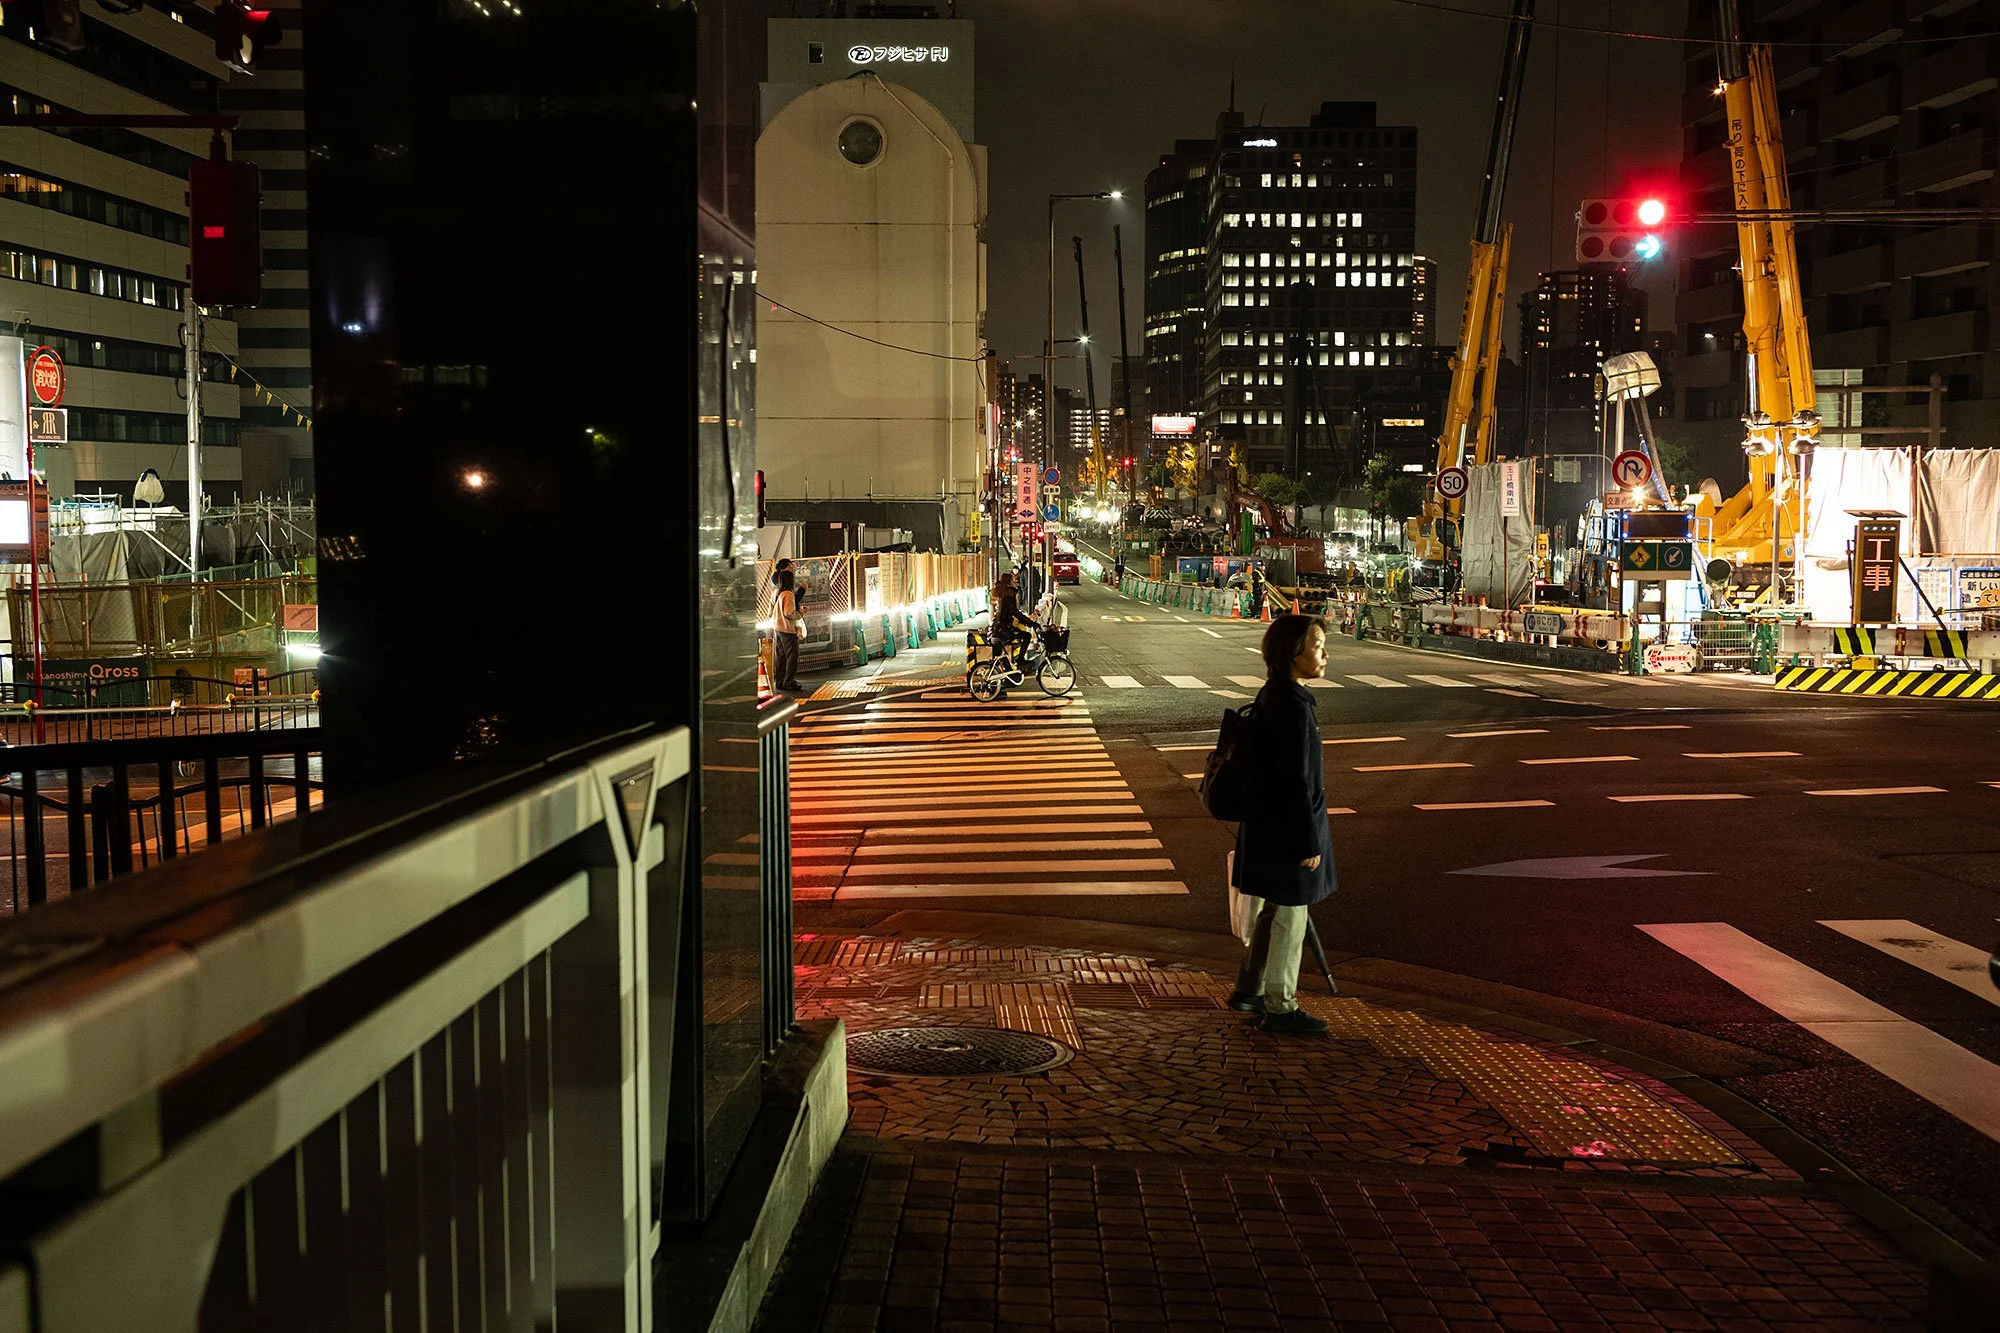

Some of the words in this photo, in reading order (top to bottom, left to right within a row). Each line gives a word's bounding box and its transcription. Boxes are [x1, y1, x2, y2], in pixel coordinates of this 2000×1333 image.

[873, 46, 928, 62] フジヒサ
[931, 46, 949, 62] FJ
[35, 368, 58, 389] 消火栓
[1443, 476, 1462, 490] 50
[1862, 538, 1893, 592] 工事
[26, 671, 88, 681] Nkanoshima
[89, 663, 139, 679] Qross
